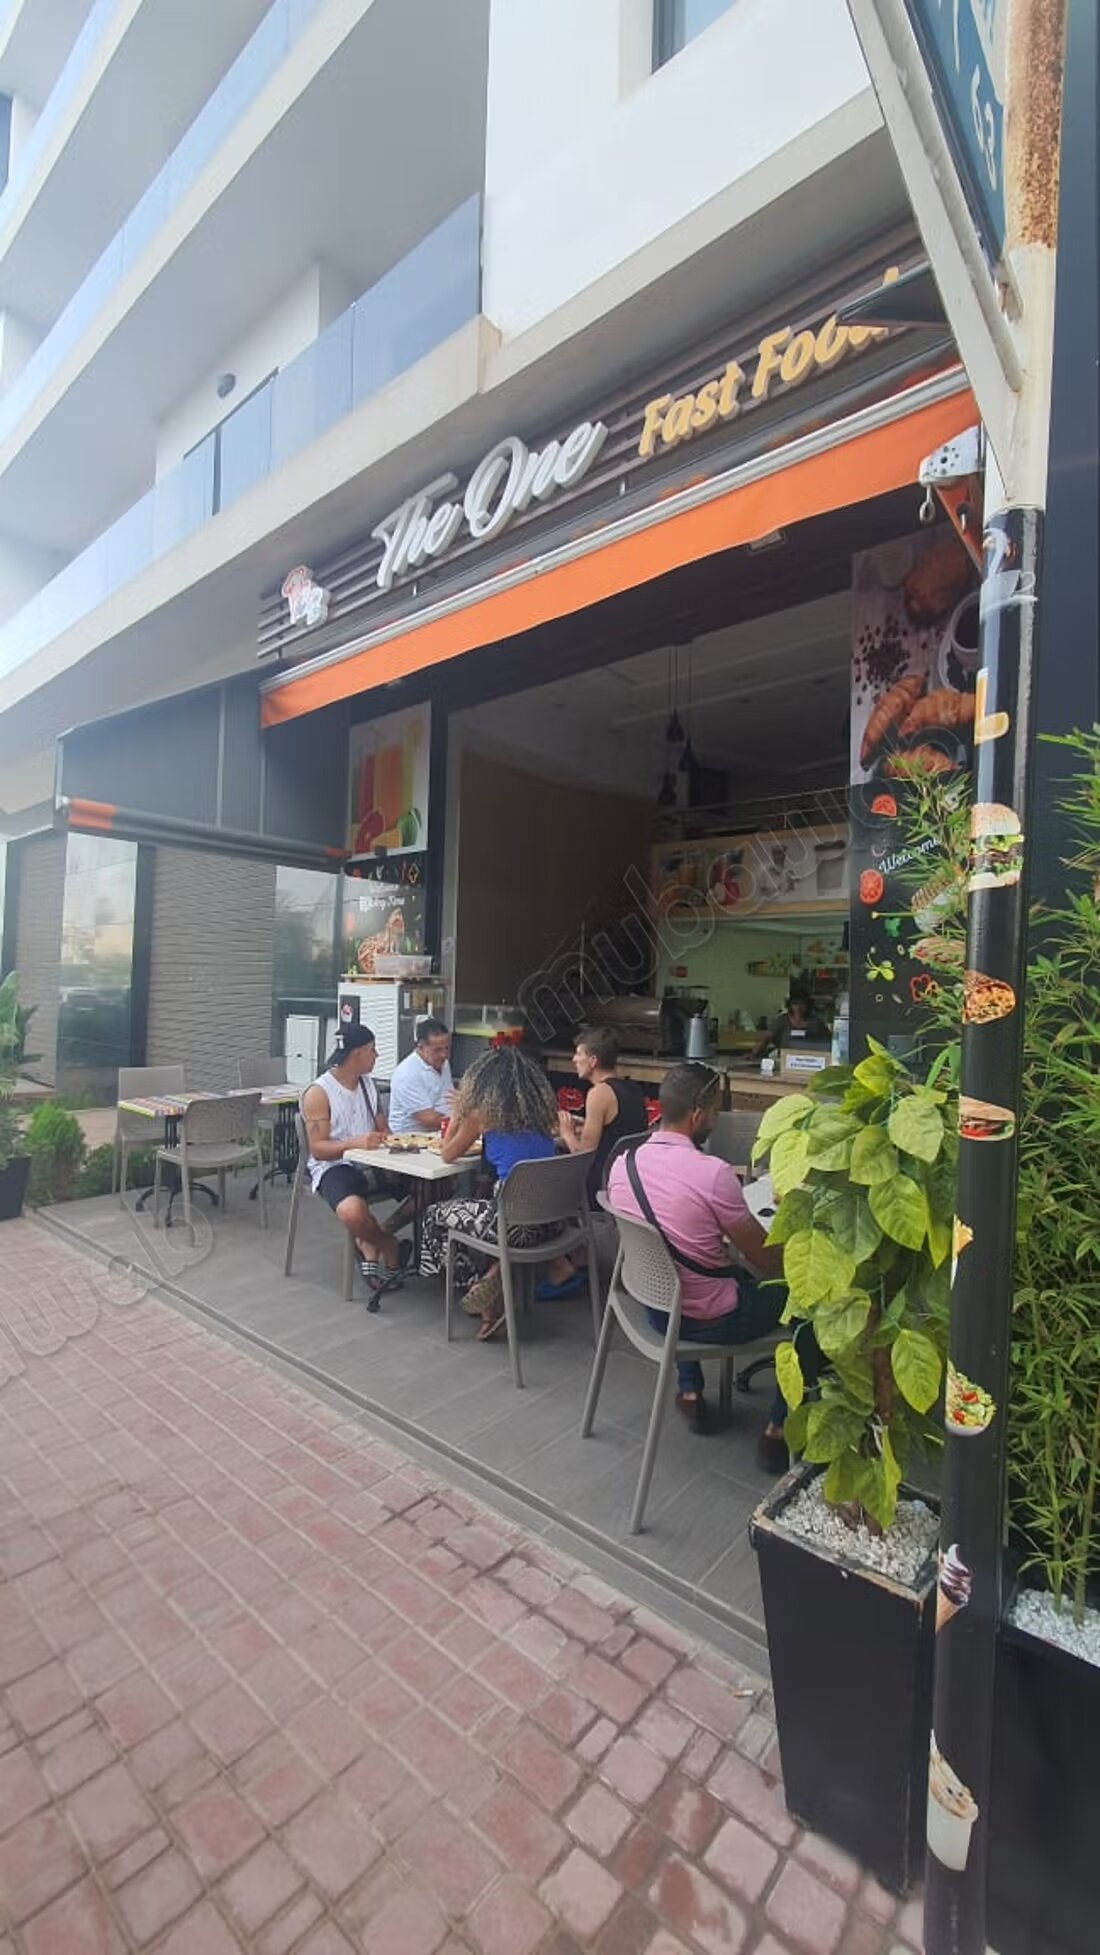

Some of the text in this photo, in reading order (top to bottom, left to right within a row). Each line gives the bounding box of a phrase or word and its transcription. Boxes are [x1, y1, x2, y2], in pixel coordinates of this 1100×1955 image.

[638, 360, 745, 459] Fast
[371, 420, 609, 590] The One
